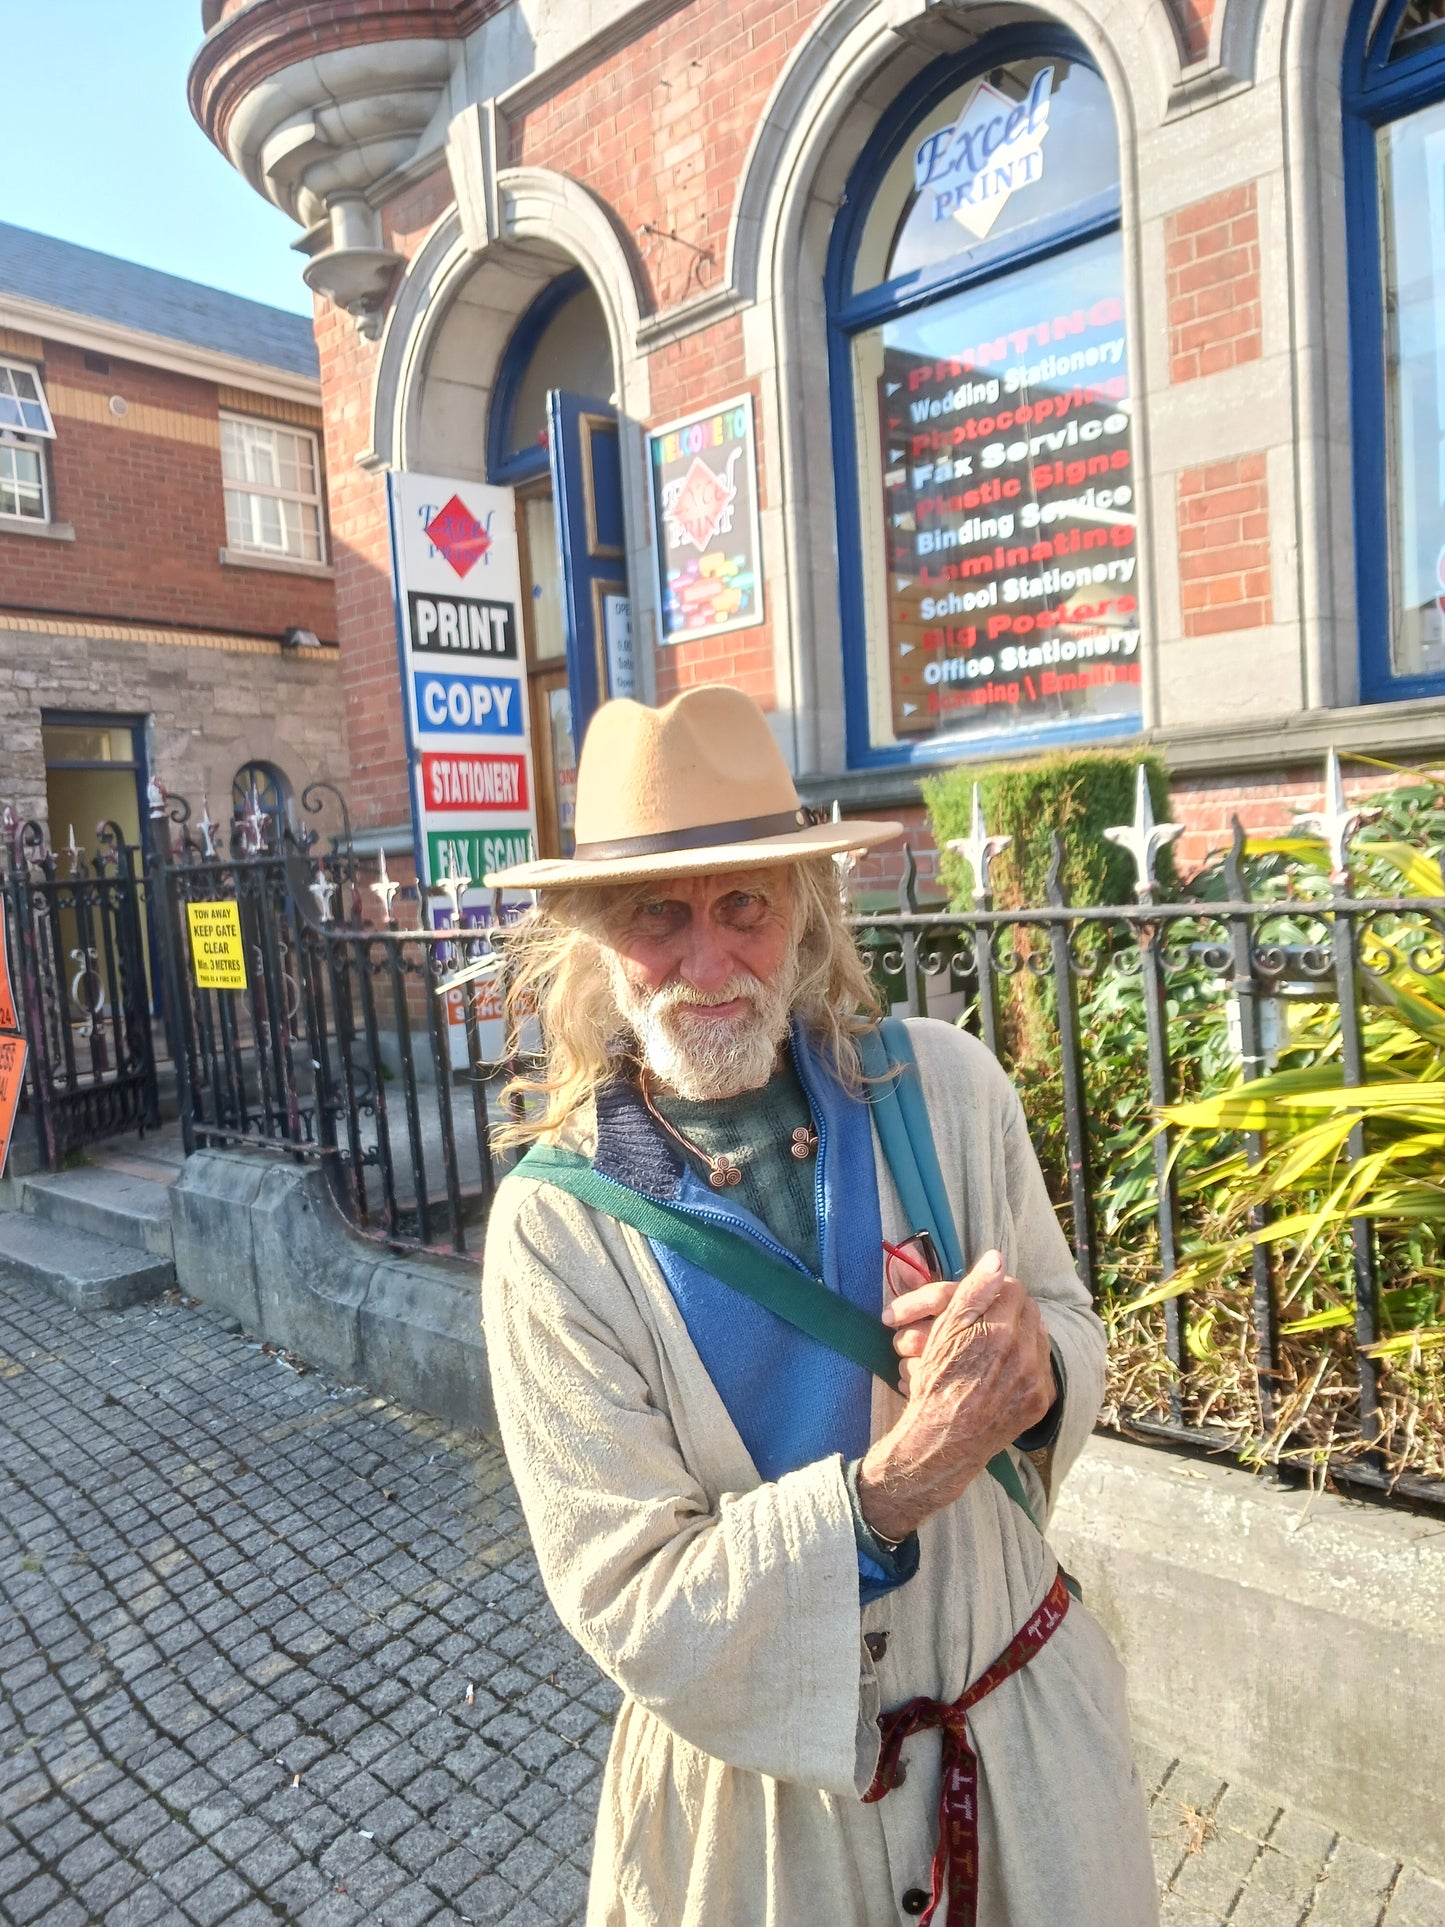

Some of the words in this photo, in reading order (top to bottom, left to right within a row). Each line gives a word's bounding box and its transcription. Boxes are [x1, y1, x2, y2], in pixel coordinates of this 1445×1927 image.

[917, 66, 1054, 188] Excel
[934, 151, 1040, 222] PRINT
[908, 298, 1123, 391] PRINTING
[910, 378, 1000, 424] Wedding
[1003, 337, 1125, 394] Stationery
[911, 376, 1127, 456] Photocopying
[912, 455, 973, 490] Fax
[981, 413, 1129, 469] Service
[916, 477, 1021, 522] Plastic
[1032, 449, 1130, 490] Signs
[917, 514, 1015, 556] Binding
[1020, 485, 1132, 529] Service
[920, 524, 1135, 586] Laminating
[920, 582, 998, 621] School
[1002, 556, 1136, 603] Stationery
[416, 599, 509, 653] PRINT
[923, 626, 977, 651] Big
[987, 594, 1137, 640] Posters
[924, 654, 995, 685] Office
[1000, 630, 1140, 672] Stationery
[424, 680, 513, 727] COPY
[432, 759, 521, 805] STATIONERY
[483, 836, 527, 876] SCAN
[194, 910, 209, 920] TOW
[211, 909, 231, 919] AWAY
[194, 925, 213, 937] KEEP
[215, 925, 237, 937] GATE
[204, 942, 229, 954] CLEAR
[210, 959, 215, 970] 3
[215, 959, 241, 971] METRES
